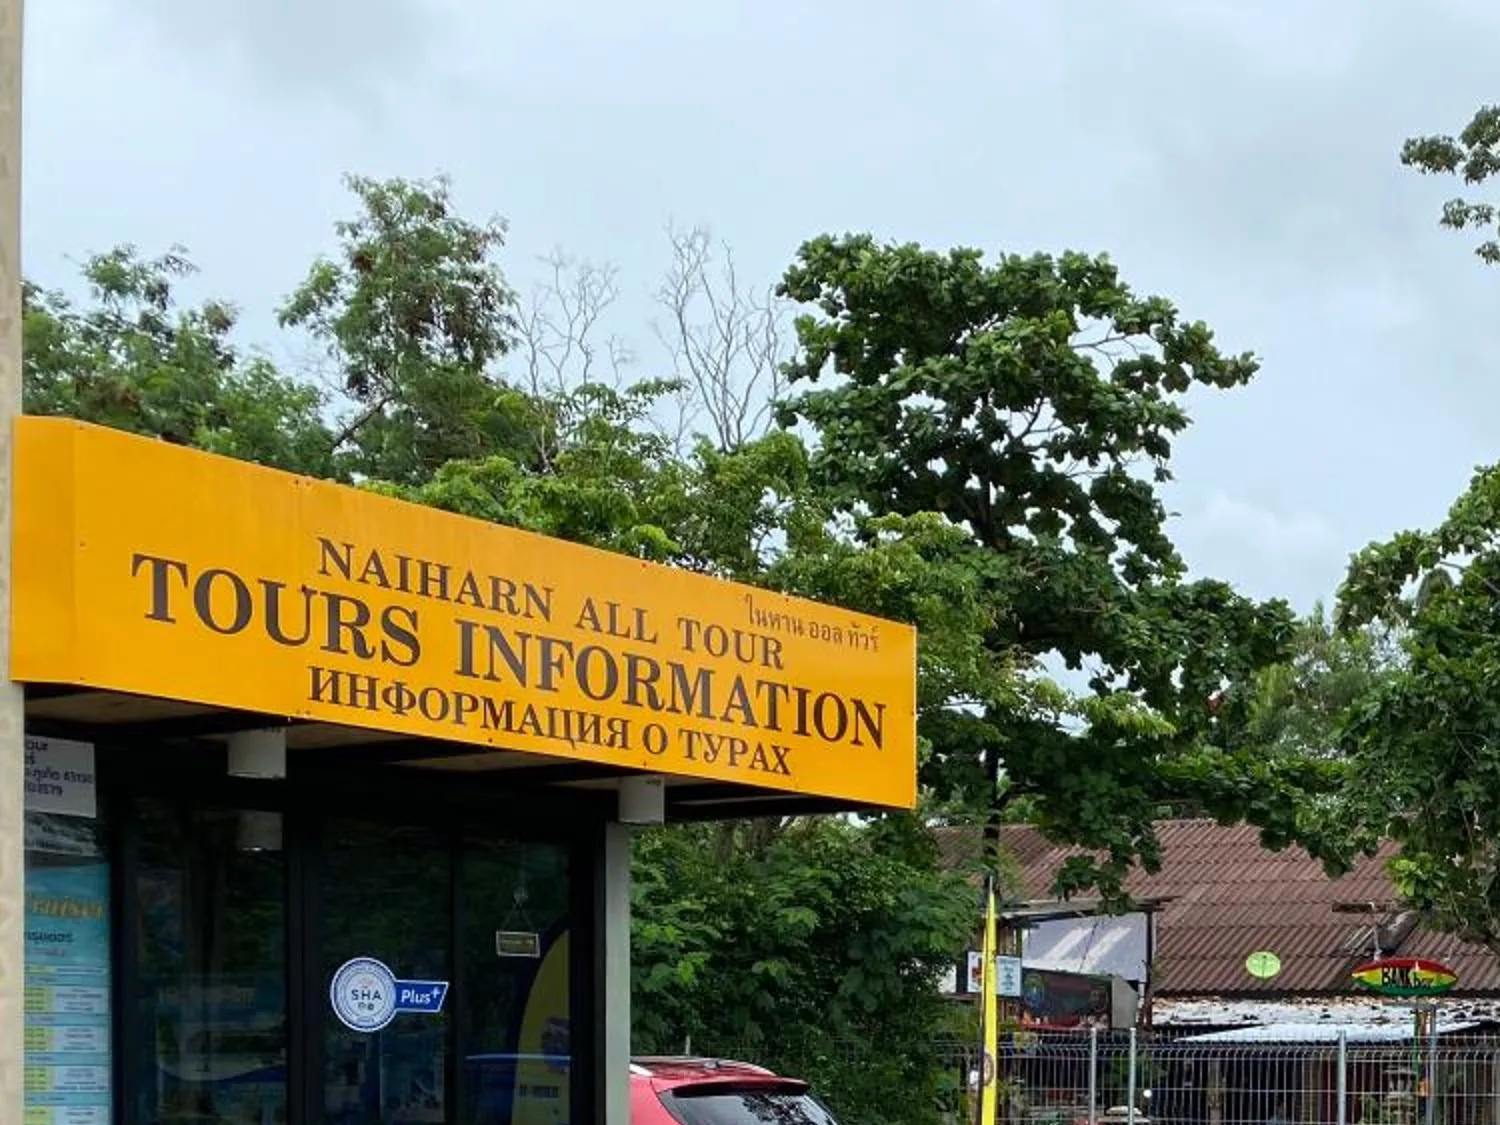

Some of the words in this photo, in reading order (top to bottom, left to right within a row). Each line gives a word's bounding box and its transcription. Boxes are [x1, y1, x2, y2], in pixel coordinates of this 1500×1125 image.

[131, 552, 421, 669] TOURS
[454, 618, 888, 750] INFORMATION
[318, 537, 554, 625] NAIHARN
[575, 598, 659, 645] ALL
[677, 617, 784, 671] TOUR
[308, 665, 632, 752] ИНФОРМАЦИЯ
[679, 728, 792, 777] ТУРАХ
[351, 989, 382, 1001] SHA
